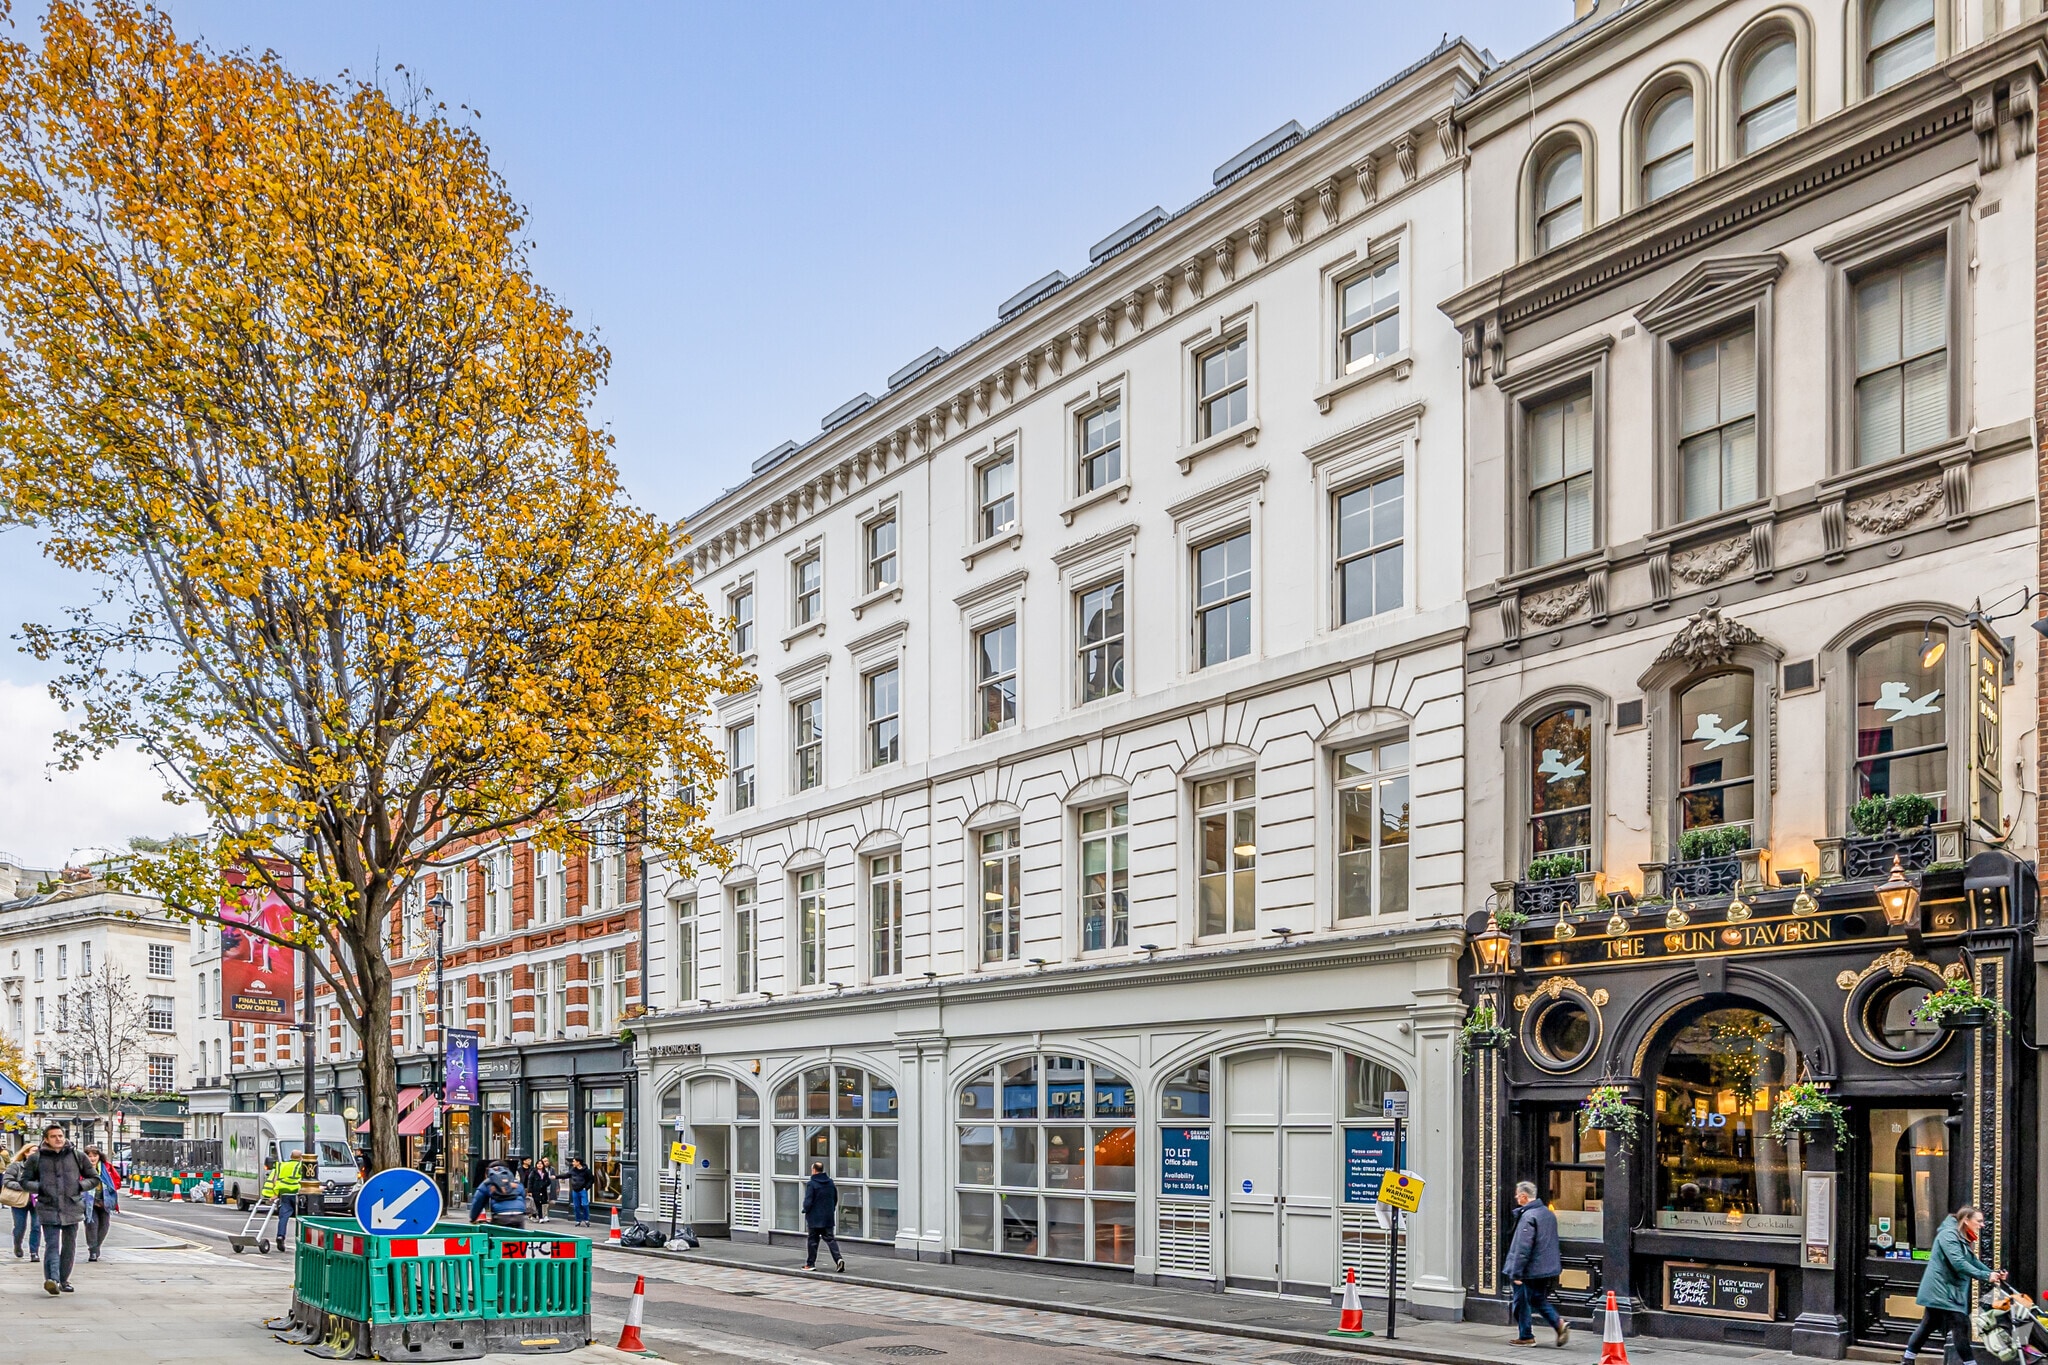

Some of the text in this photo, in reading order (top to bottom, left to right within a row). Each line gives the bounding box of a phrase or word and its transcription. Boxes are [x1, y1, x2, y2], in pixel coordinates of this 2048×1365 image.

[1935, 912, 1955, 925] 66
[1602, 919, 1832, 959] THE SUN TAVERN
[238, 997, 279, 1007] FINAL DATES
[1164, 1148, 1191, 1158] TO LET
[1164, 1158, 1198, 1166] Office Suites
[1164, 1171, 1195, 1181] Availability
[1385, 1187, 1415, 1202] WARNING
[1390, 1195, 1407, 1204] Parking
[1746, 1217, 1794, 1229] Cocktails
[1695, 1272, 1711, 1280] CLUB
[1718, 1278, 1764, 1289] EVERY WEEKDAY
[1722, 1286, 1739, 1294] UNTIL
